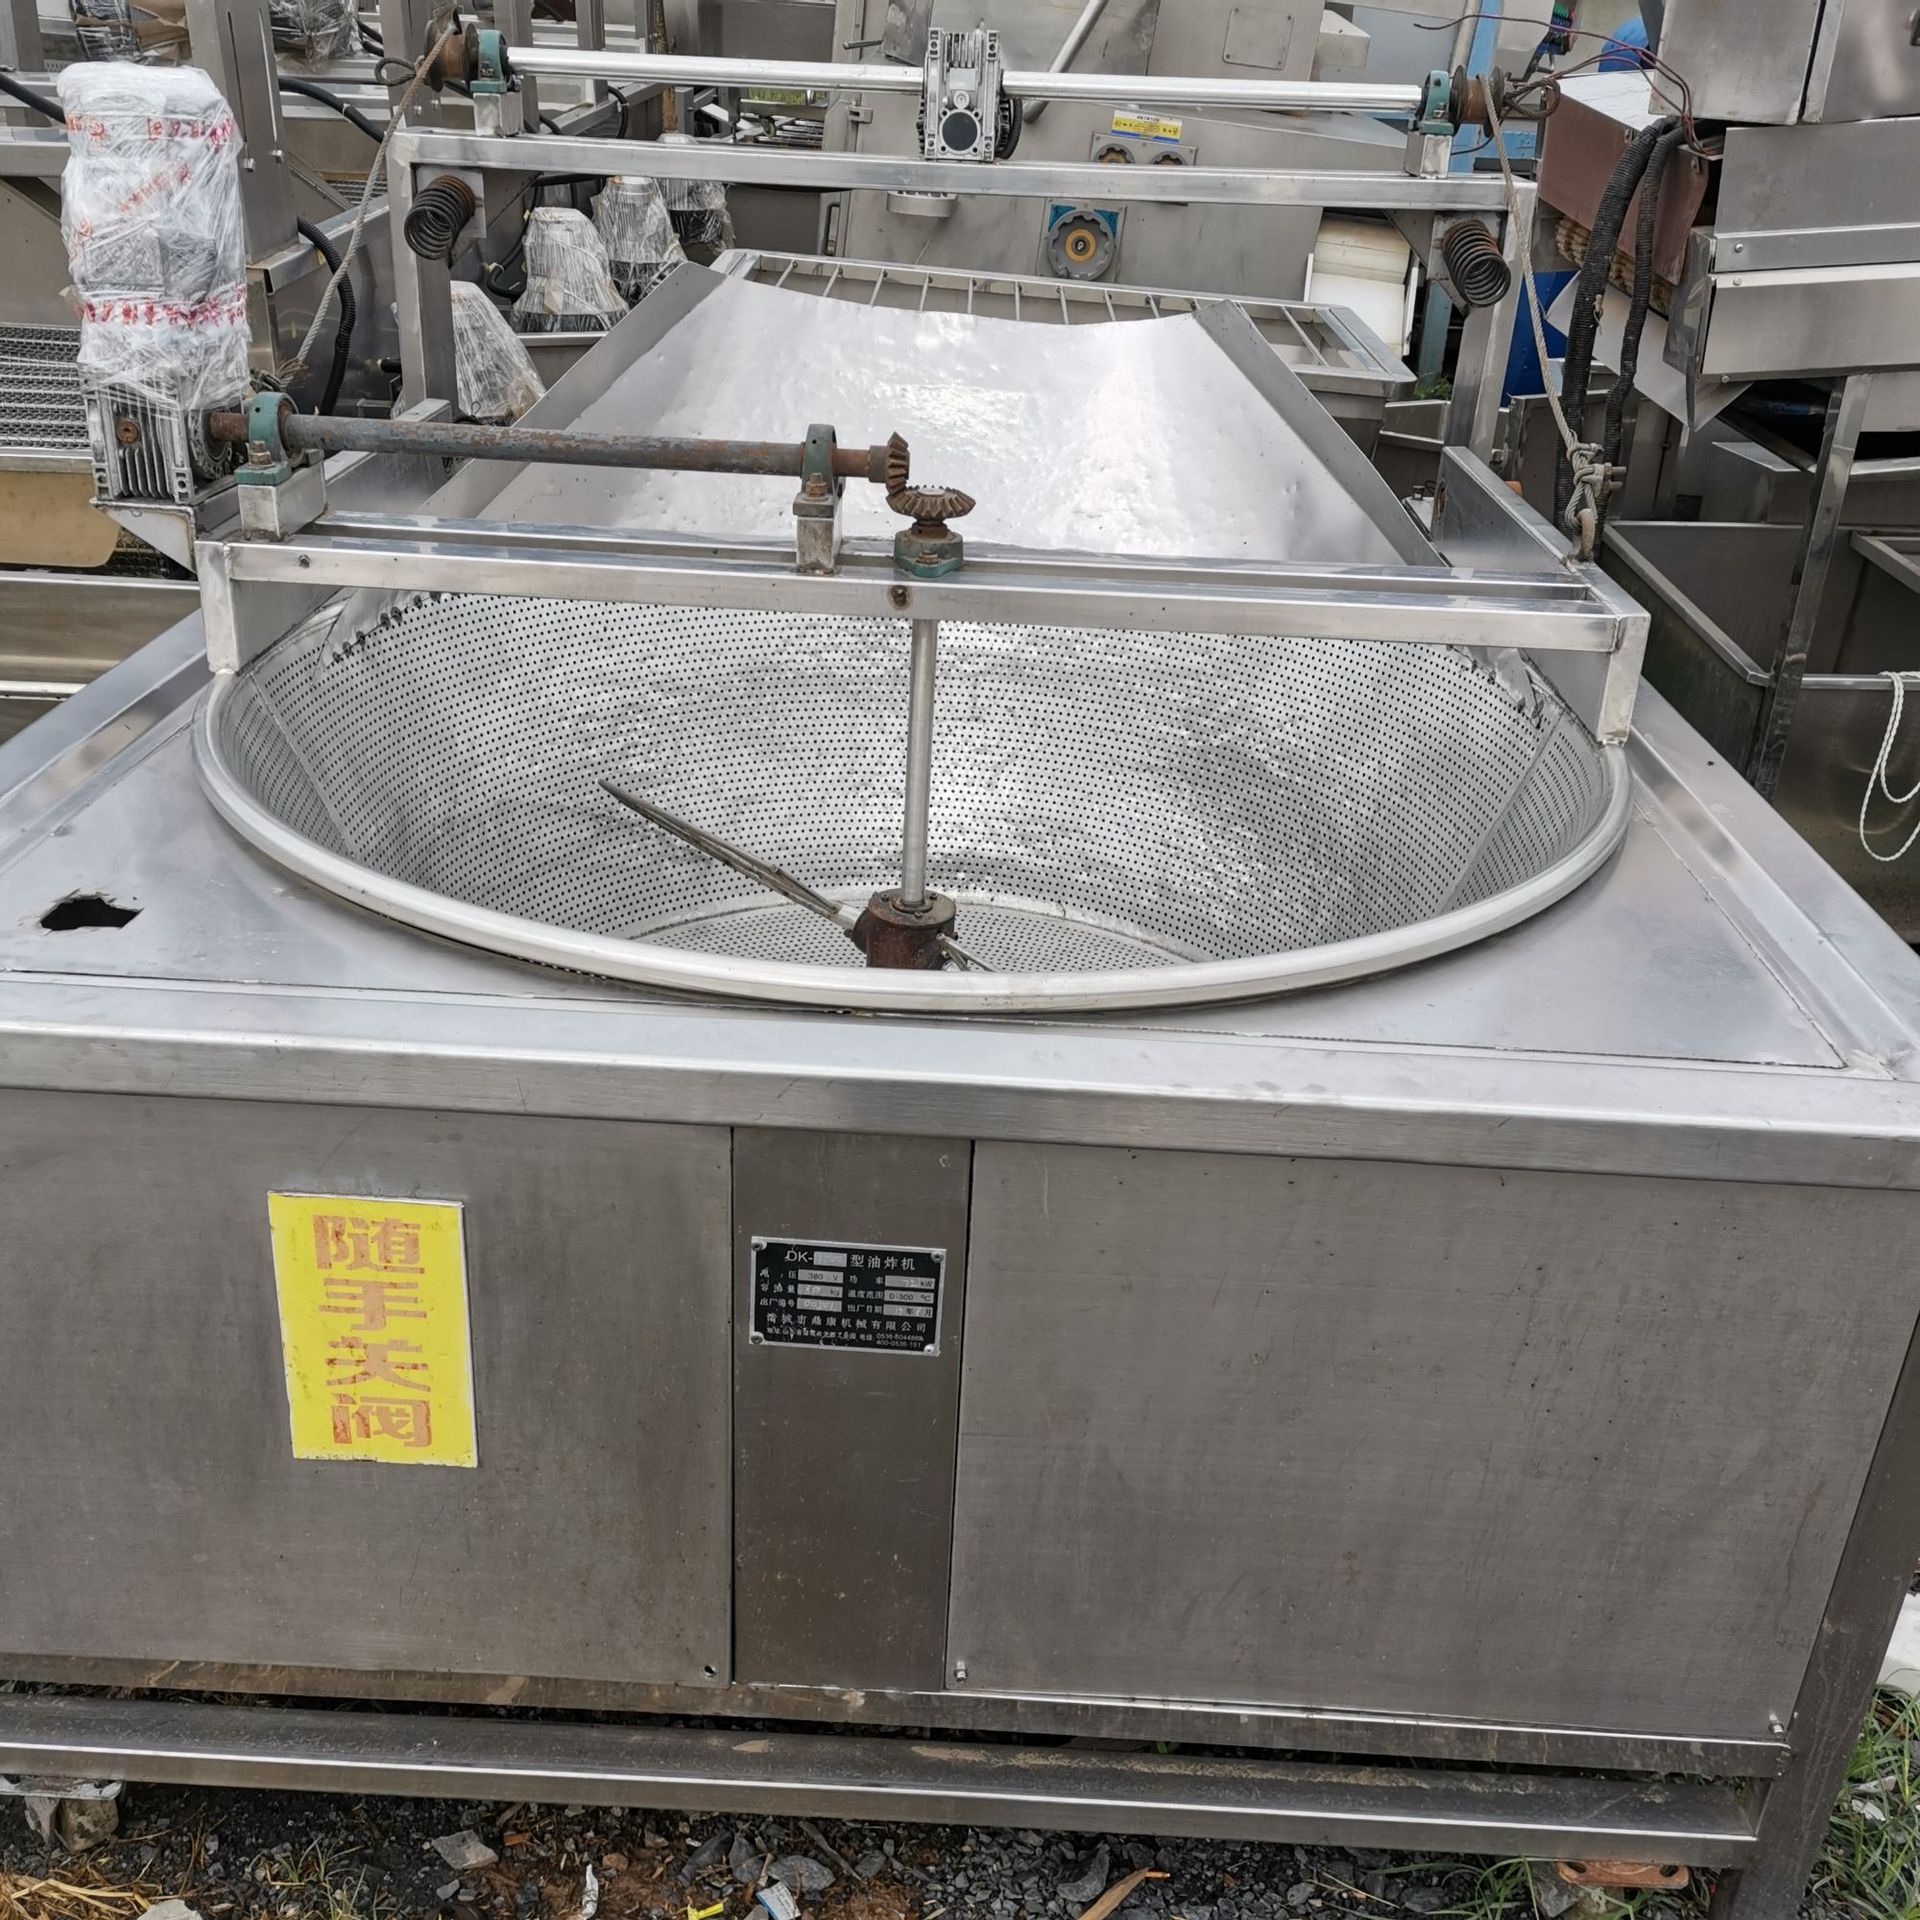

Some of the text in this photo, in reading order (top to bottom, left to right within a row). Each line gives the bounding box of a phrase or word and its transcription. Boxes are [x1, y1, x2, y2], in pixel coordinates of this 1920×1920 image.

[850, 1254, 916, 1271] 型油炸机
[847, 1289, 883, 1300] 温度范围
[847, 1304, 883, 1314] 出厂日期
[313, 1215, 432, 1448] 随手关阀
